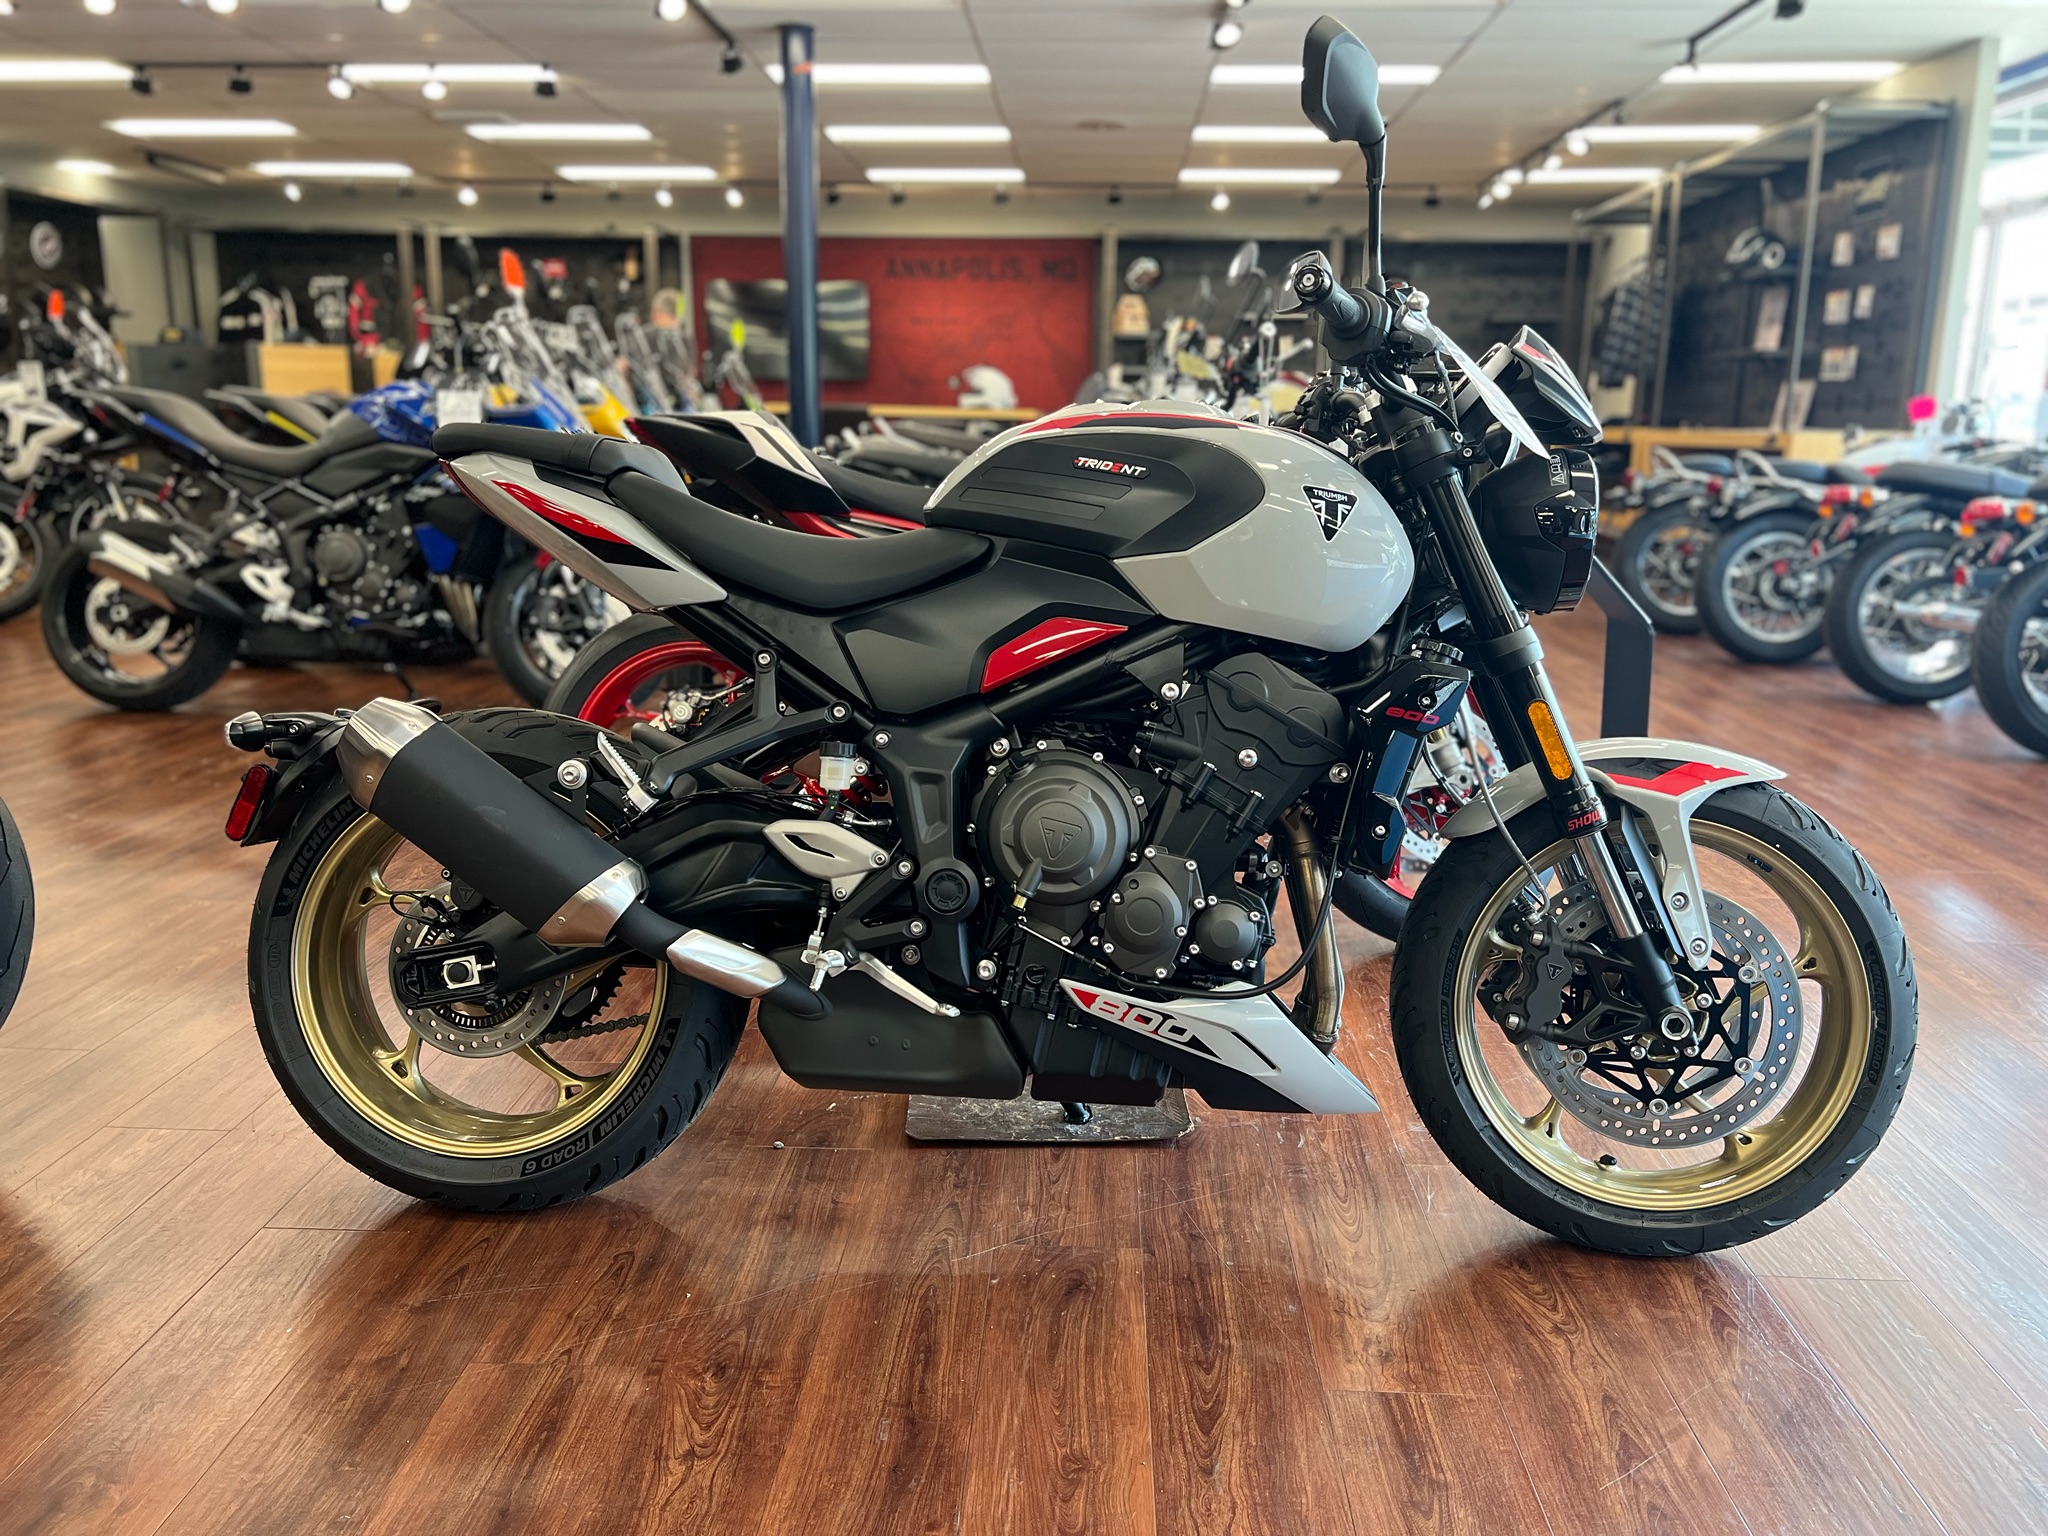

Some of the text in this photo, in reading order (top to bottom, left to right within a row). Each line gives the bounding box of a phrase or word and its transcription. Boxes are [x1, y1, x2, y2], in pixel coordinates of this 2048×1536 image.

[1074, 456, 1147, 476] TRIDENT
[1312, 488, 1348, 502] TRIUMPH
[1385, 706, 1440, 725] 800
[288, 800, 354, 885] MICHELIN
[1443, 963, 1454, 994] 120/70
[1090, 994, 1195, 1043] 800
[1442, 1004, 1456, 1064] MICHELIN
[1868, 963, 1887, 1081] MICHELIN ROAD 6
[525, 1052, 666, 1174] MICHELIN ROAD 6
